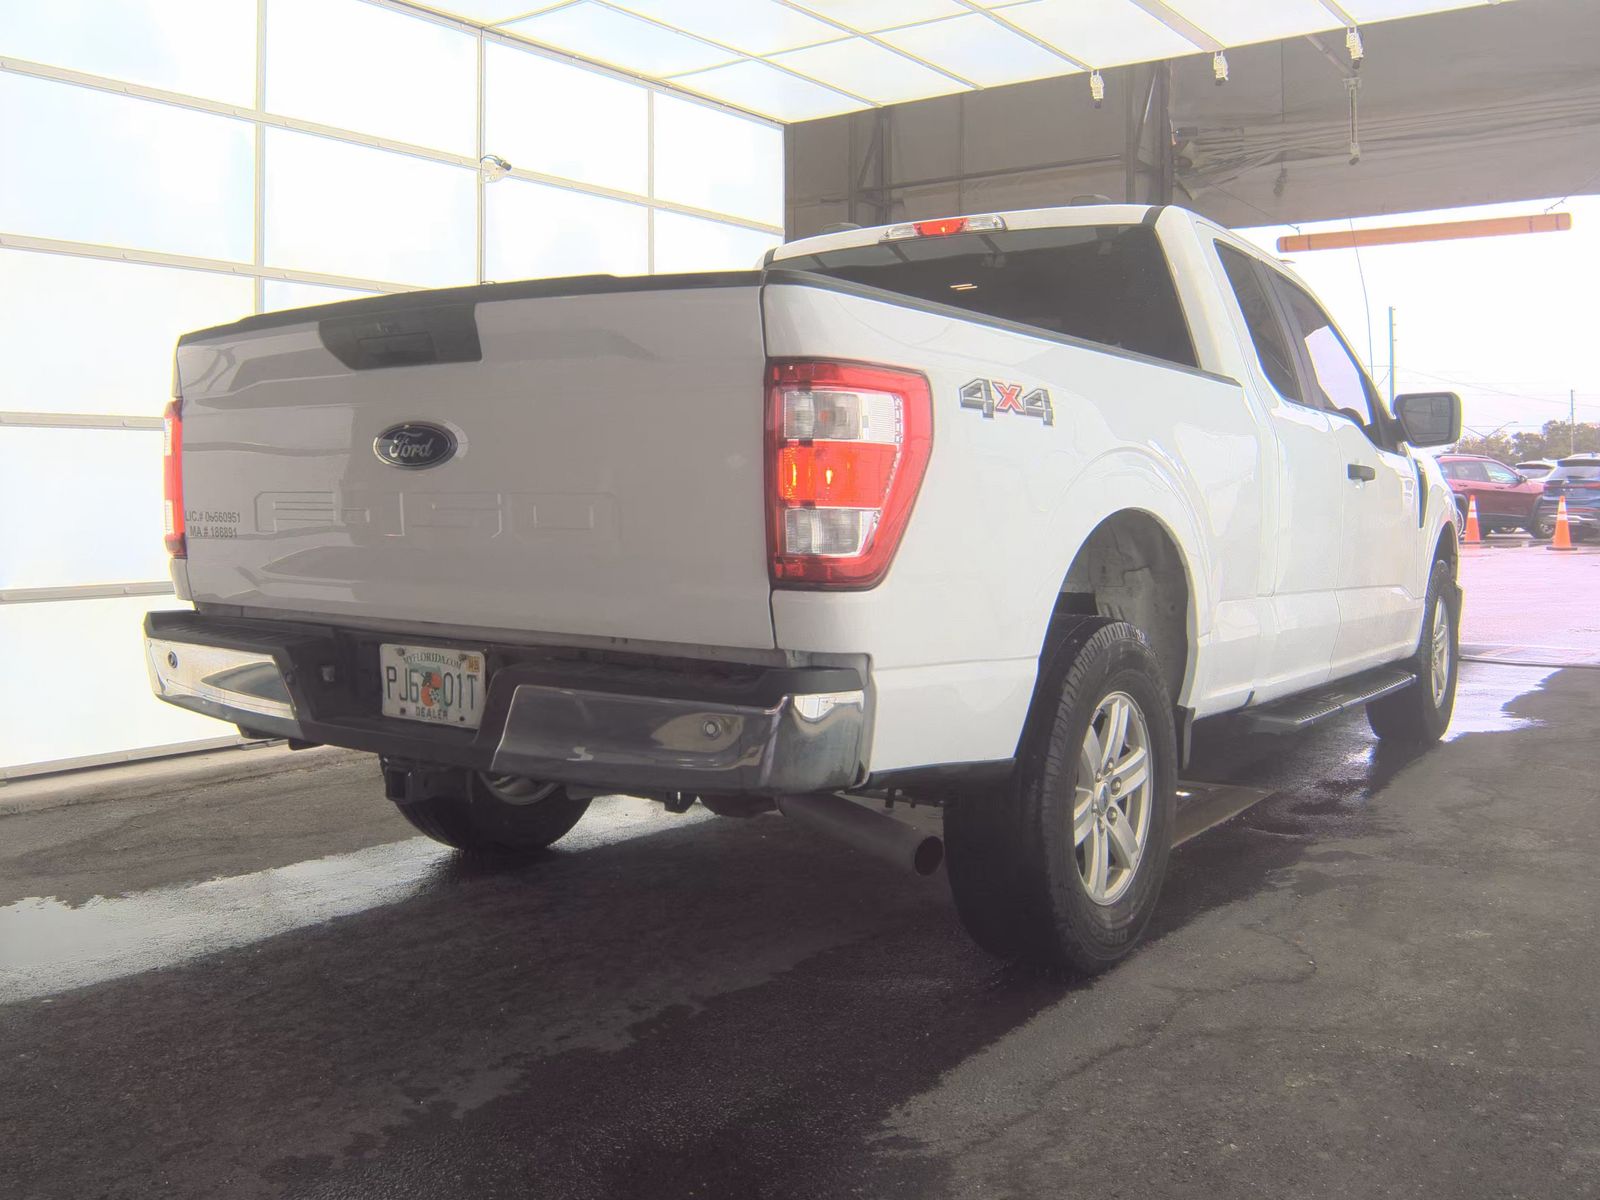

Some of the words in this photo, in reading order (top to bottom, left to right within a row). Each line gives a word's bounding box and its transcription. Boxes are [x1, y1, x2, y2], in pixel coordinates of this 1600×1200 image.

[389, 431, 433, 458] Ford
[386, 666, 419, 703] PJ6
[415, 706, 448, 720] DEALER
